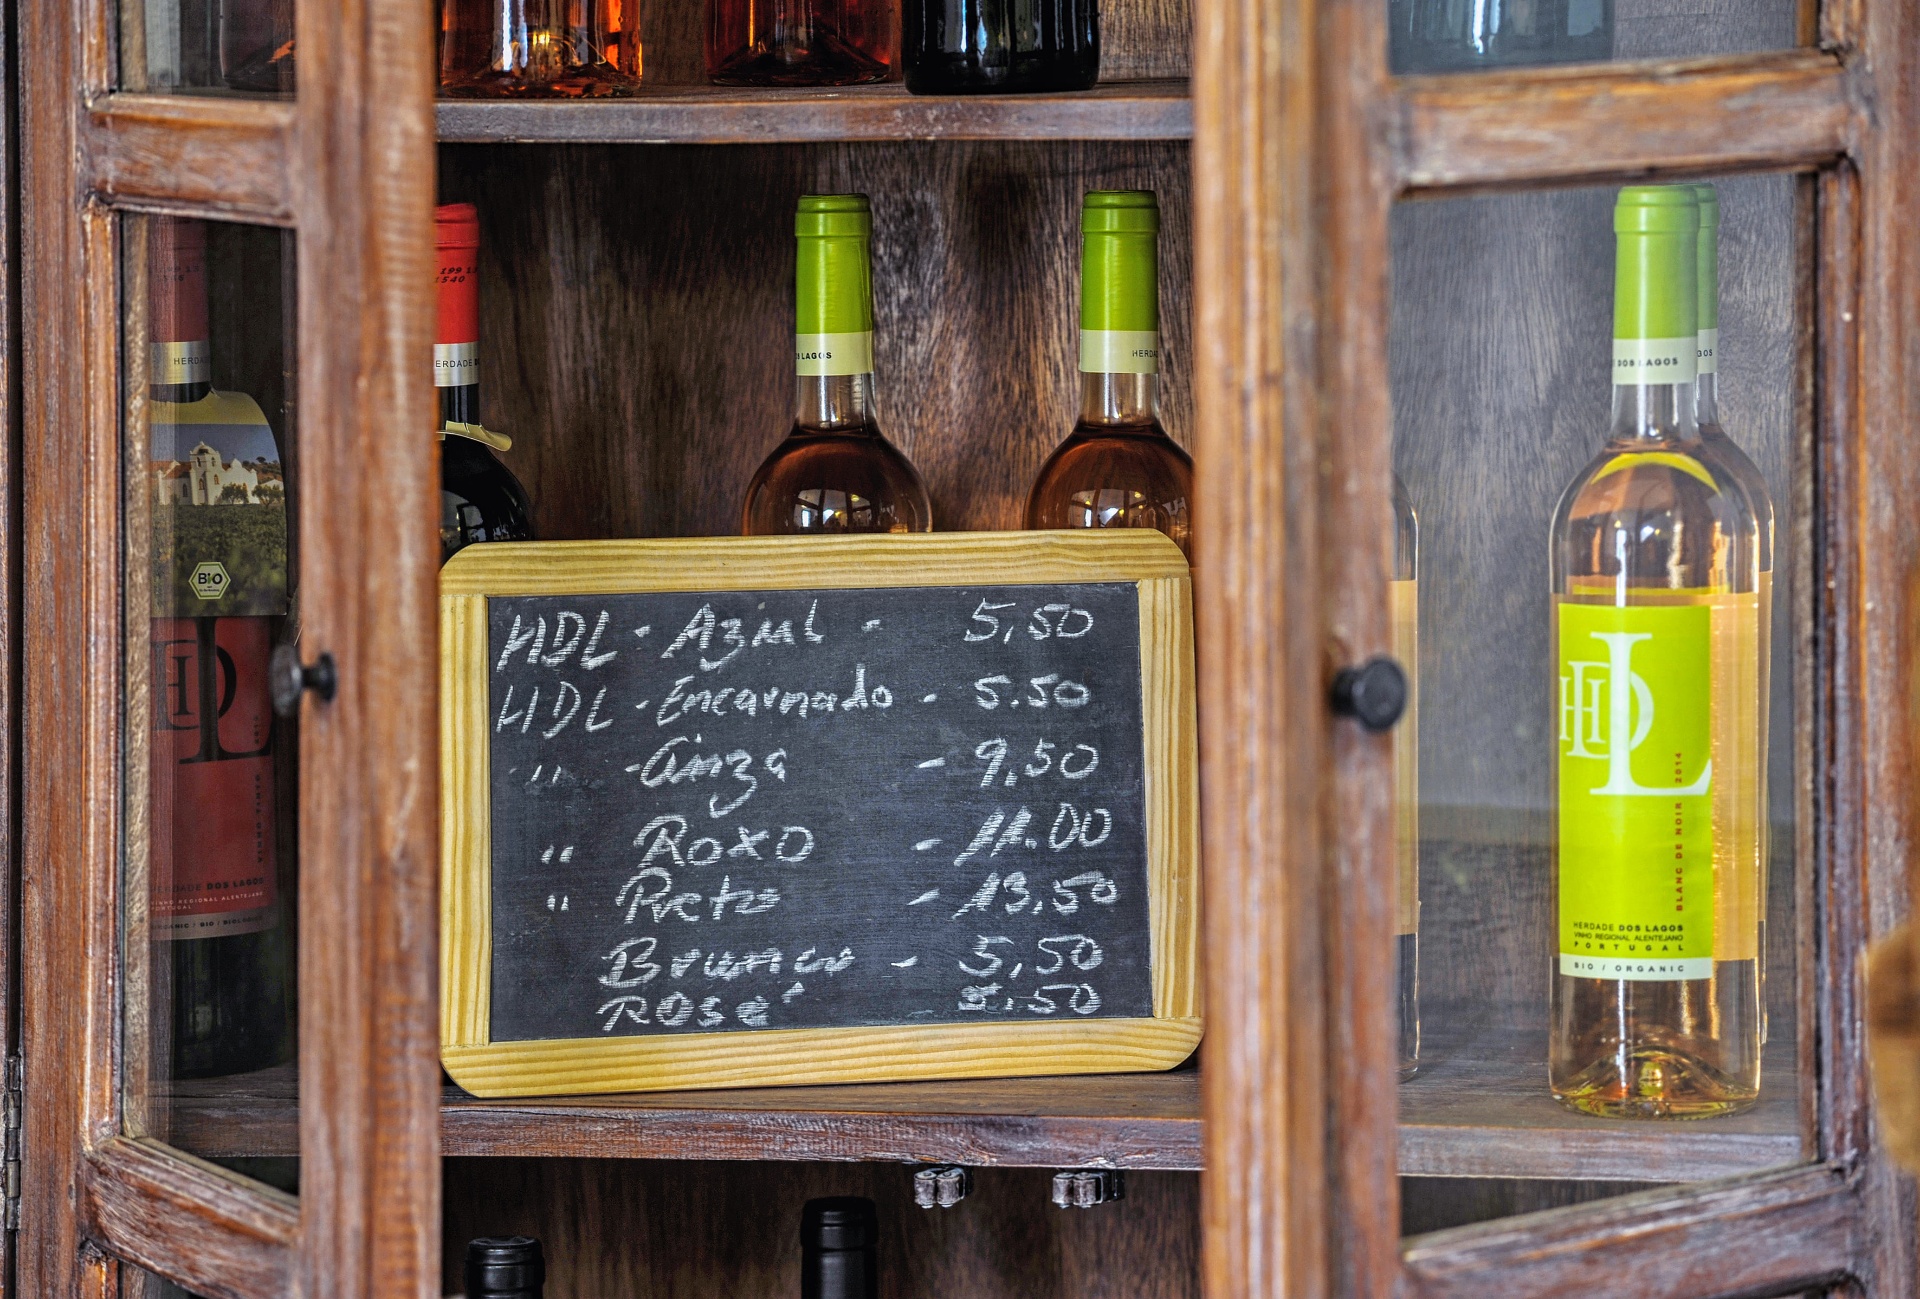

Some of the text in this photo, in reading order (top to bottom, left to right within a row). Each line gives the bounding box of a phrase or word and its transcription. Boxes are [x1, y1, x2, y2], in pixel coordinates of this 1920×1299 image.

[496, 609, 618, 672] HDL
[660, 598, 825, 673] Azul
[963, 598, 1094, 644] 5,50
[496, 680, 613, 740] HDL
[1674, 752, 1683, 911] BLANC DE NOIR 2014
[1573, 921, 1614, 932] HERDADE
[1574, 932, 1684, 942] VINHO REGIONAL ALENTEJANO
[958, 934, 1104, 980] 5,50
[1574, 962, 1594, 970] BIO
